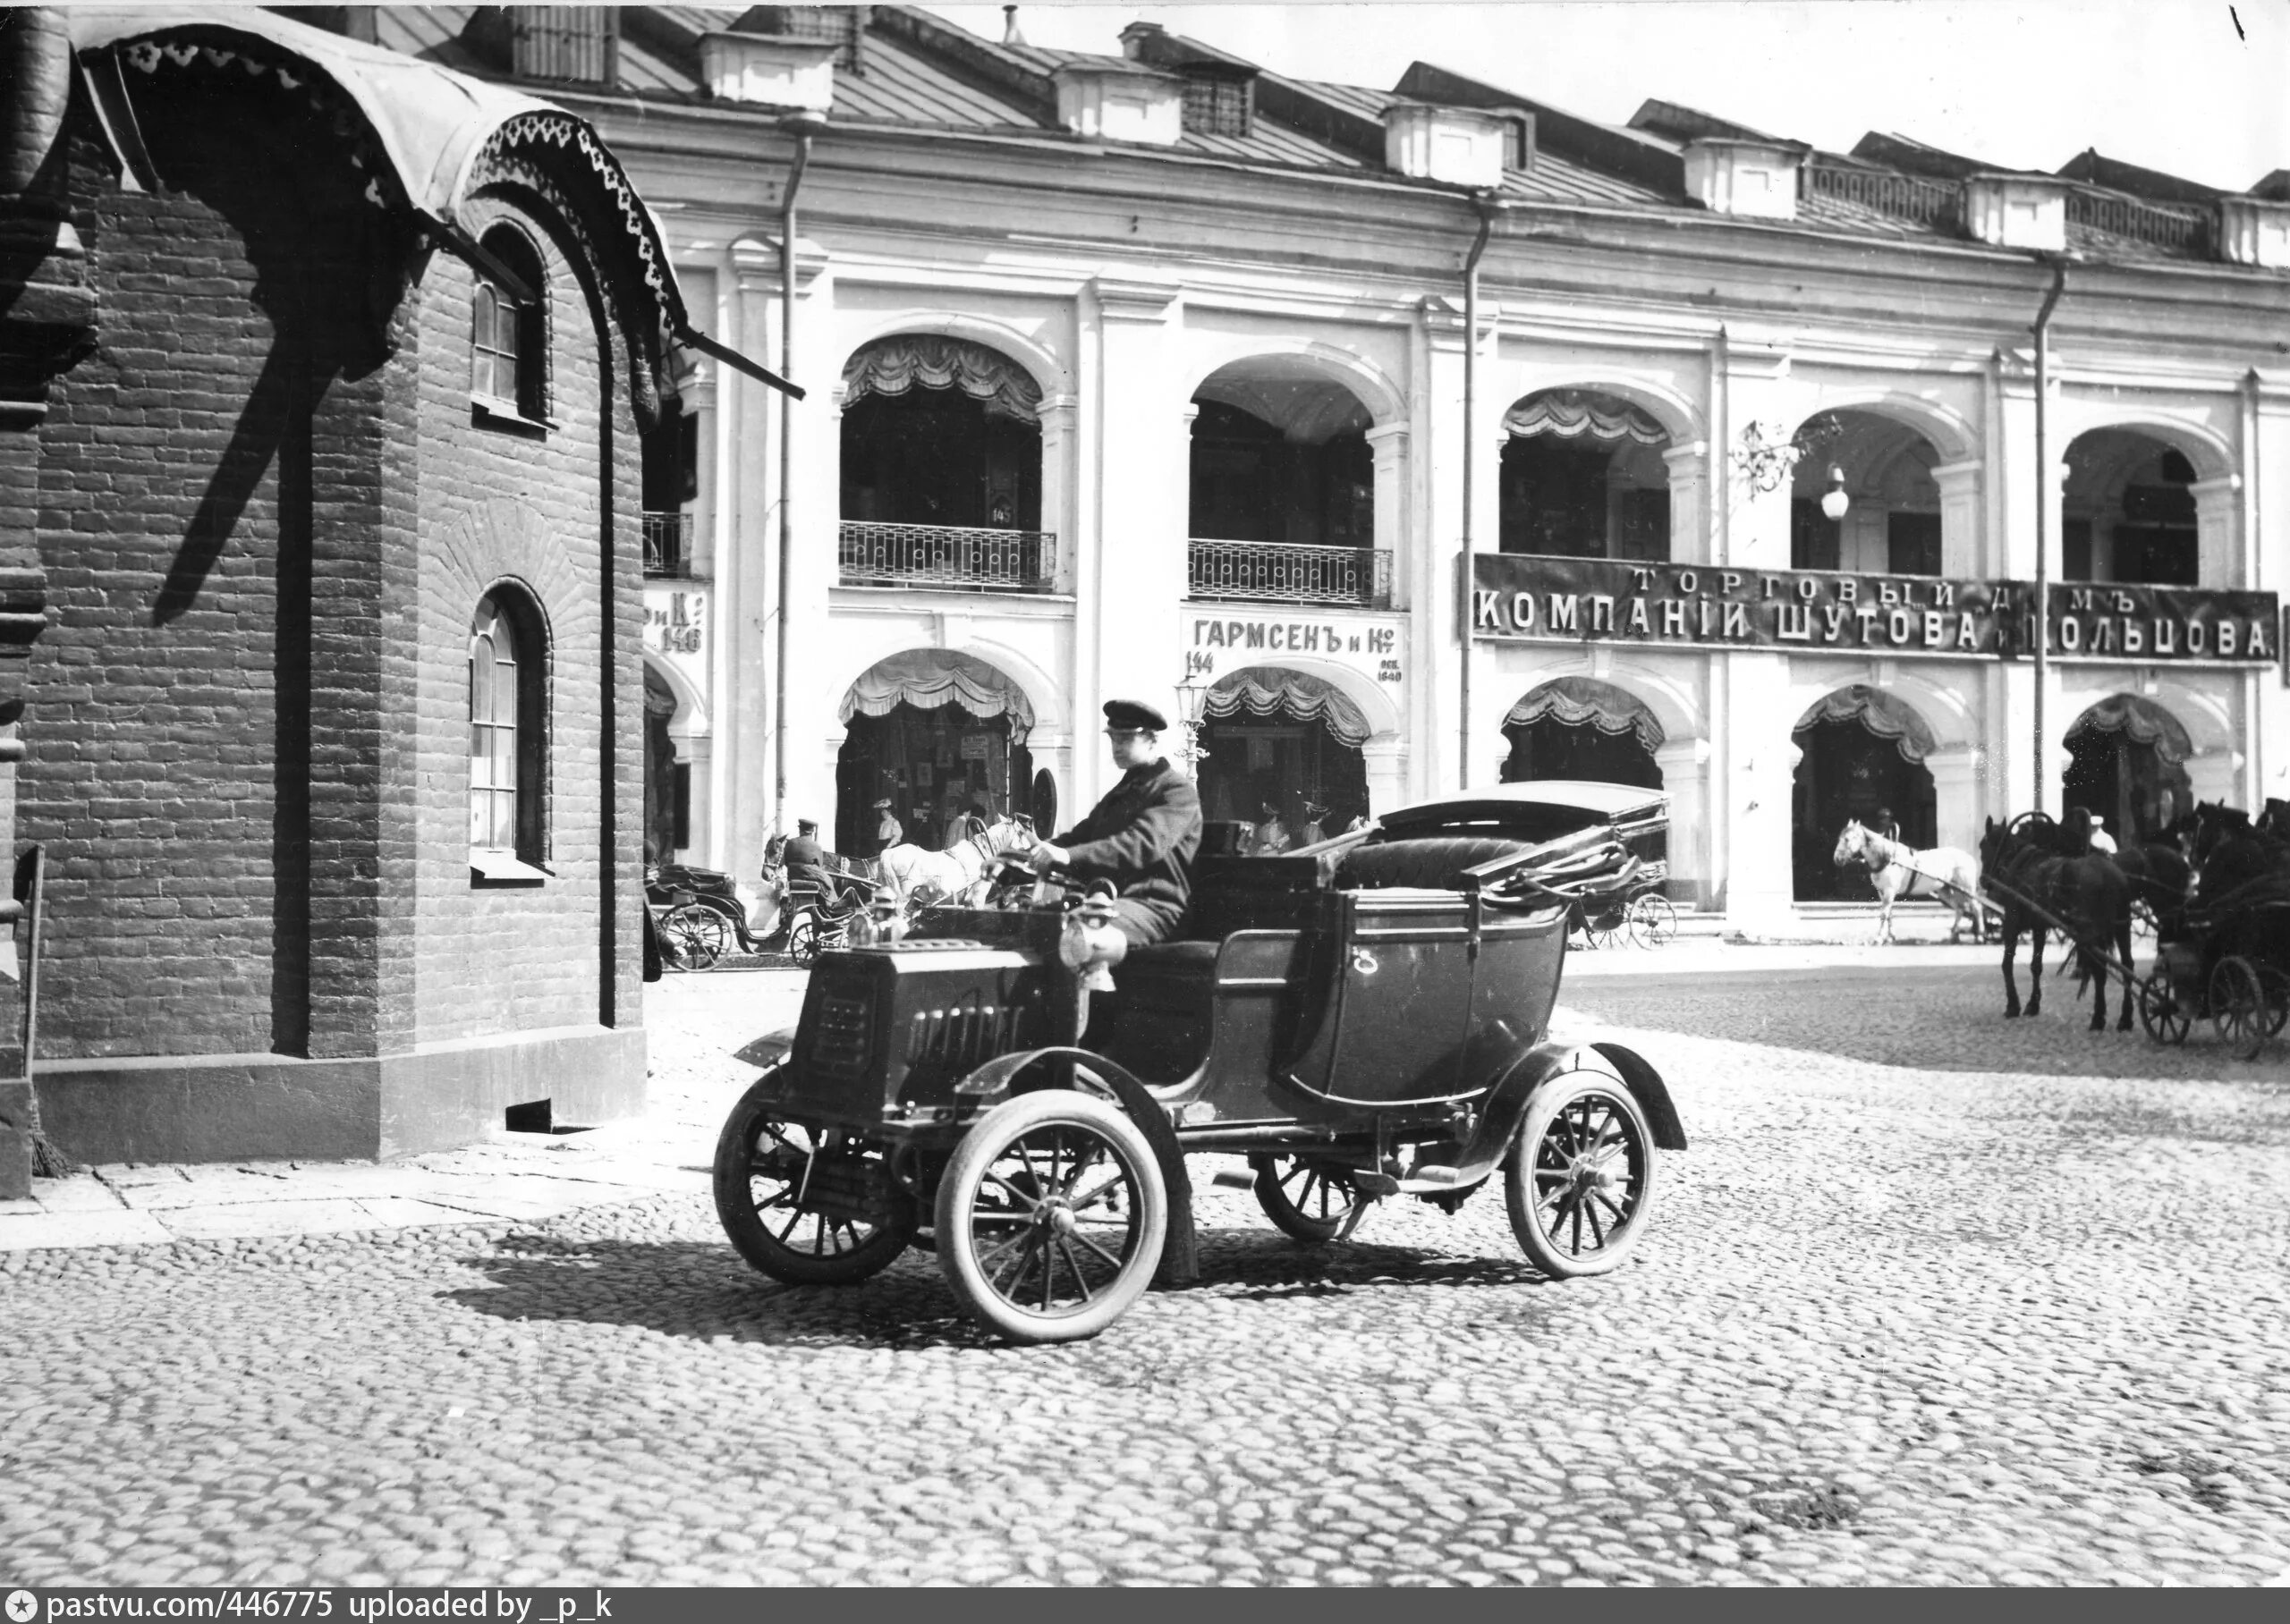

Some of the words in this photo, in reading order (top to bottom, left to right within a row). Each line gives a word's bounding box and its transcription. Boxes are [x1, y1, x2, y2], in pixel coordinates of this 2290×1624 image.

[1633, 568, 1955, 606] ТОРГОВЫЙ
[1991, 586, 2135, 613] ДМЪ
[661, 627, 702, 653] 146
[1194, 619, 1343, 654] ГАРМСЕНЪ
[1348, 635, 1361, 653] и
[1777, 603, 1979, 648] ШУТОВА
[1186, 651, 1214, 674] 144
